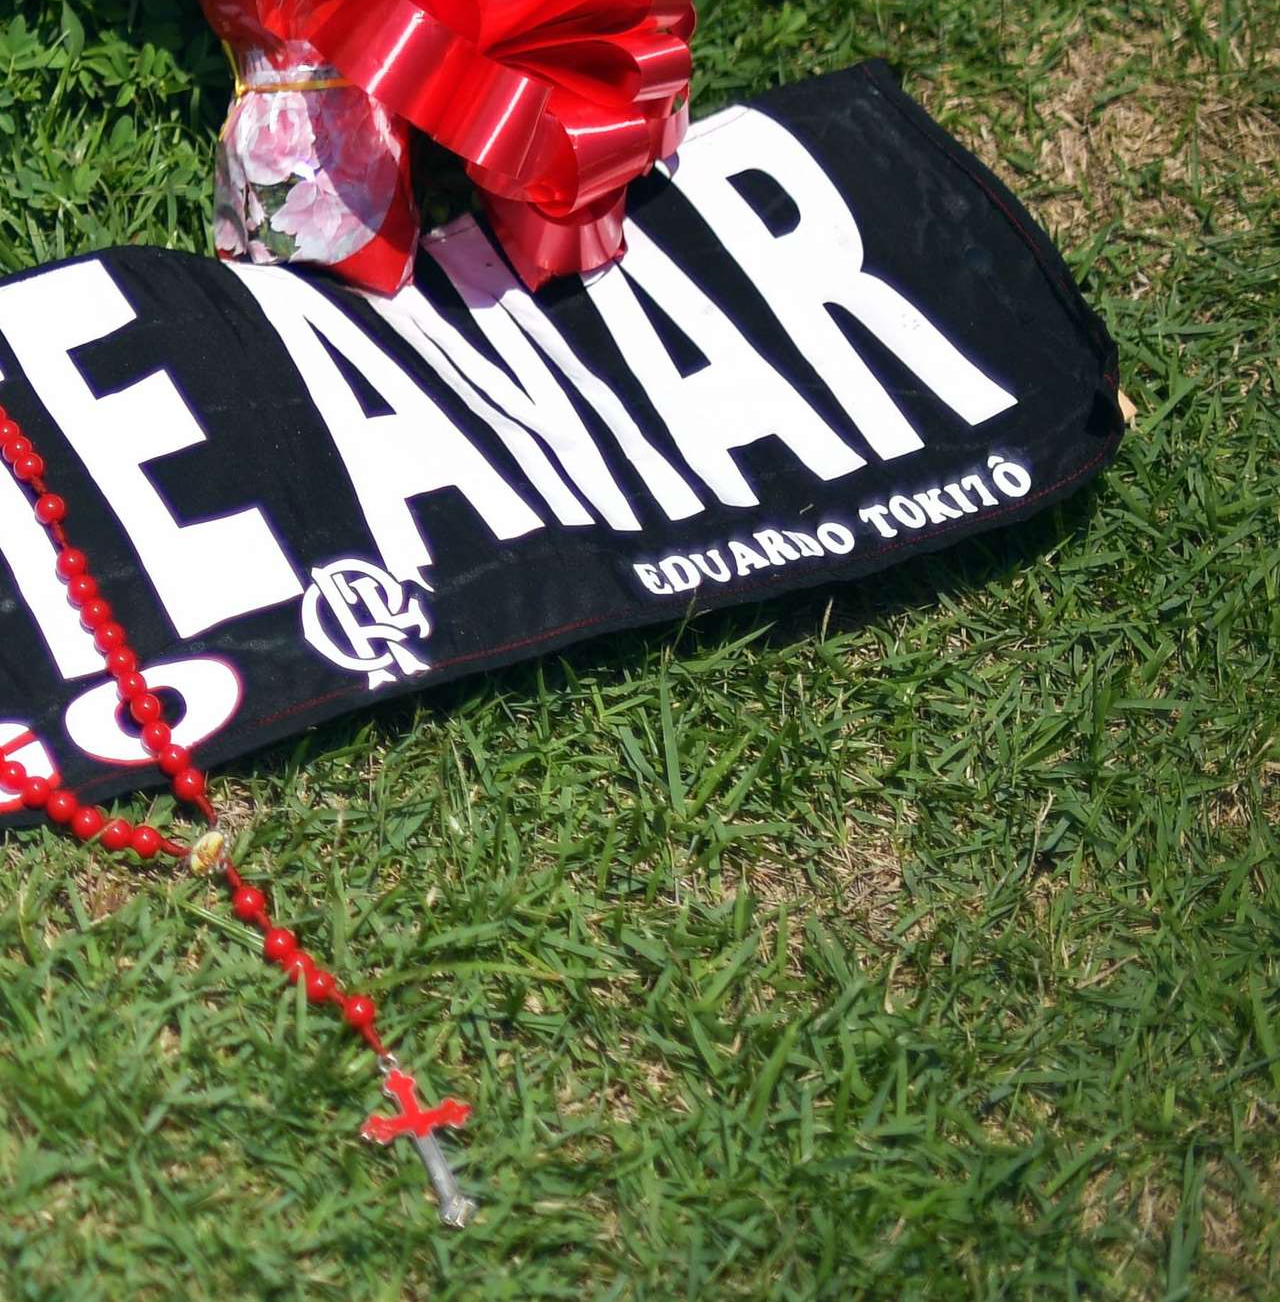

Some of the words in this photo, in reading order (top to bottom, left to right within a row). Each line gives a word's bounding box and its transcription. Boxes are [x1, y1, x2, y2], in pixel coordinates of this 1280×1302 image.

[219, 104, 1018, 584] AMAR
[633, 521, 856, 595] EDUARDO
[858, 454, 1032, 539] TOKITÔ
